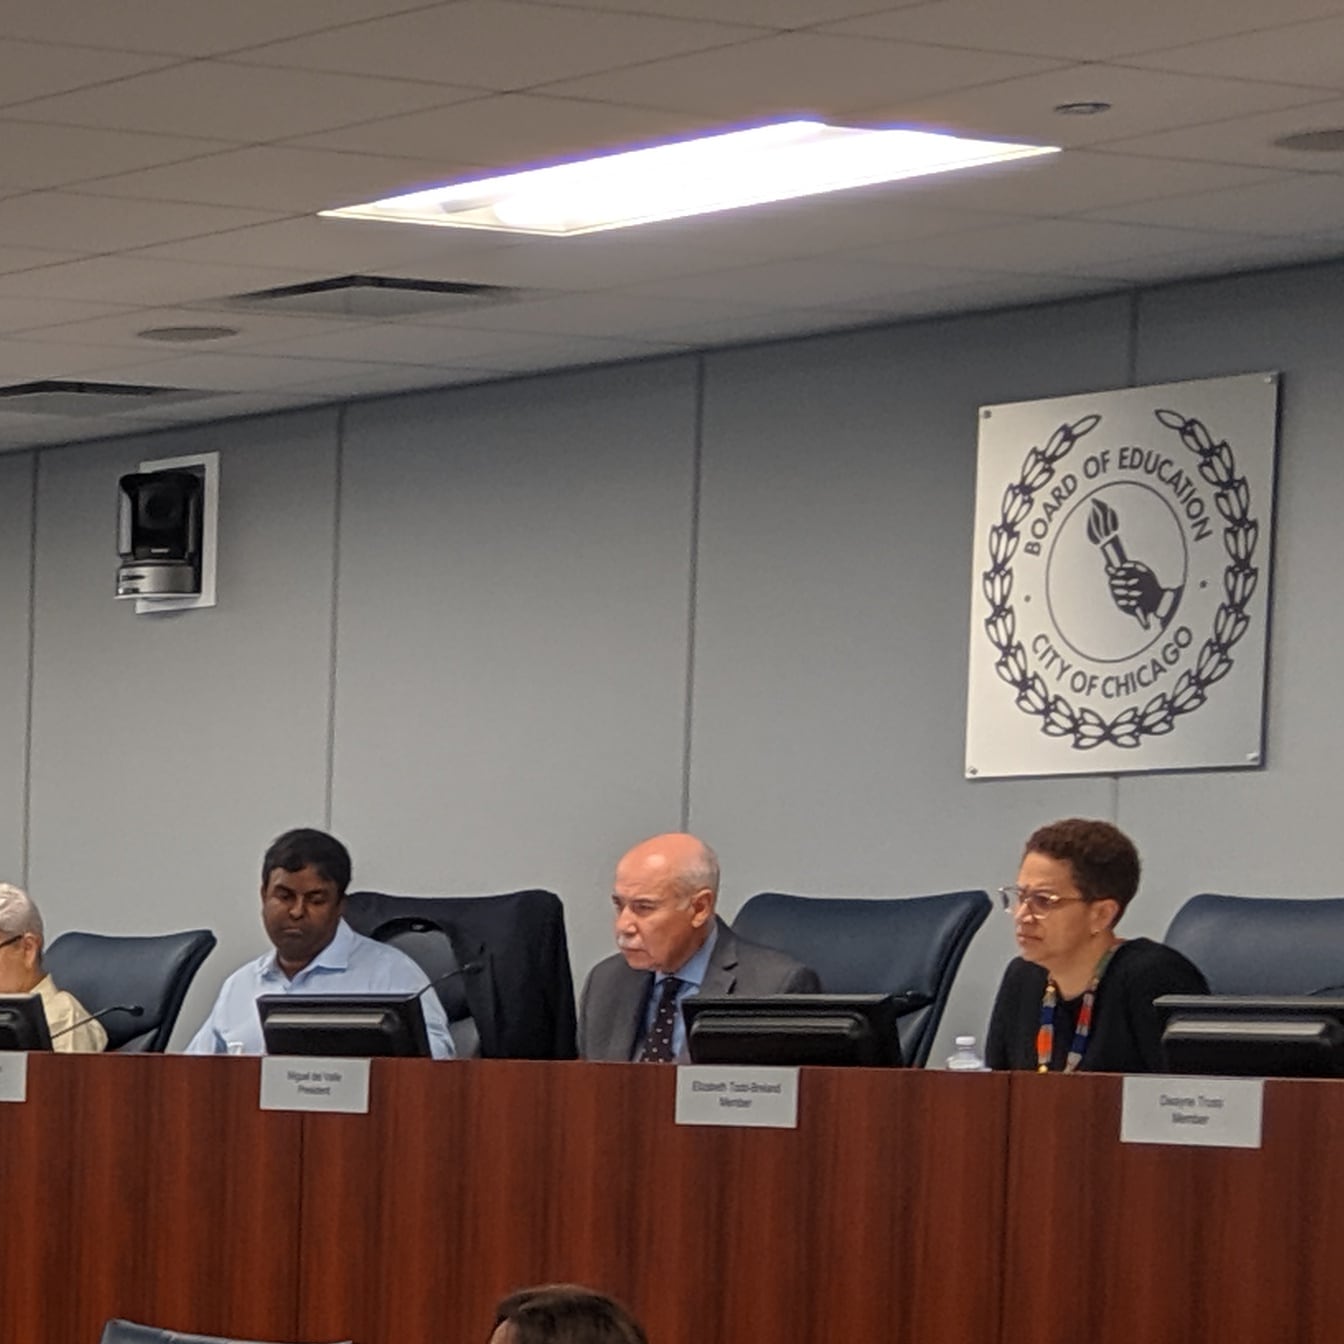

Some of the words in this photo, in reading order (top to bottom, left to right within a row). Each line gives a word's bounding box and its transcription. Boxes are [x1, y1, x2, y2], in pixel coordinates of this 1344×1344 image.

[1024, 474, 1078, 557] BOARD
[1082, 449, 1111, 480] OF
[1118, 446, 1213, 542] EDUCATION
[1031, 633, 1073, 682] CITY
[1070, 670, 1101, 698] OF
[1101, 625, 1193, 699] CHICAGO
